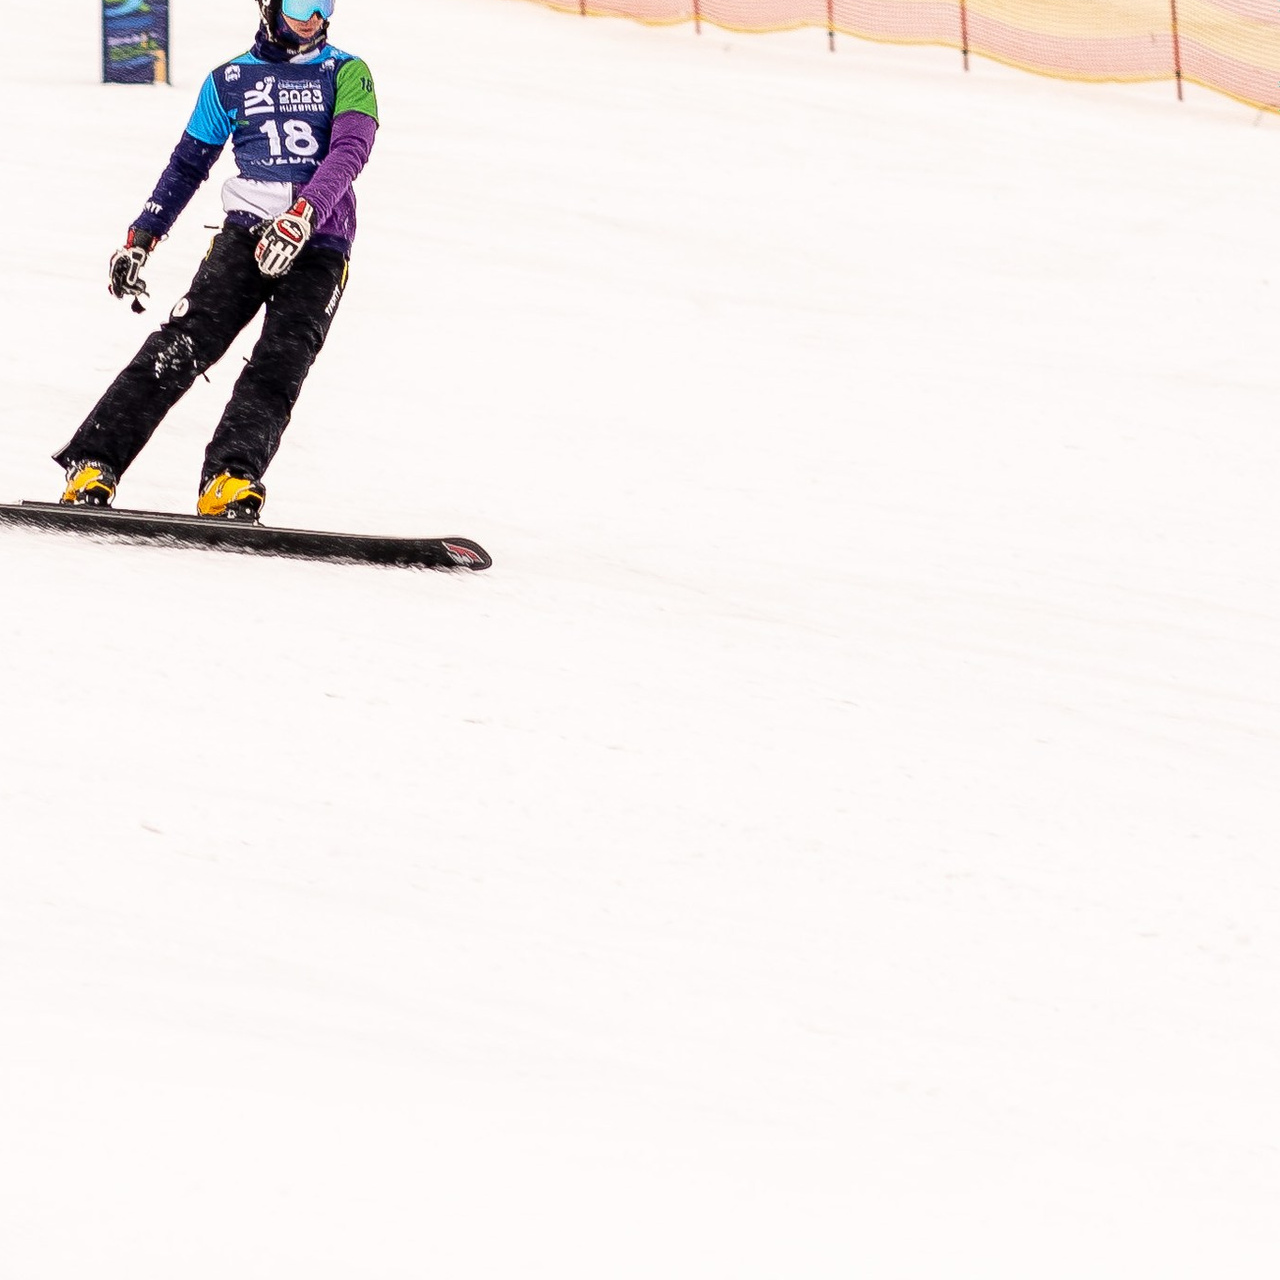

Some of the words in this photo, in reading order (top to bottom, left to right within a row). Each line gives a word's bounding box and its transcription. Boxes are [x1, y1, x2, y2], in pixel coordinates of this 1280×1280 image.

[360, 77, 373, 92] 18
[279, 89, 323, 103] 2023
[259, 119, 319, 156] 18
